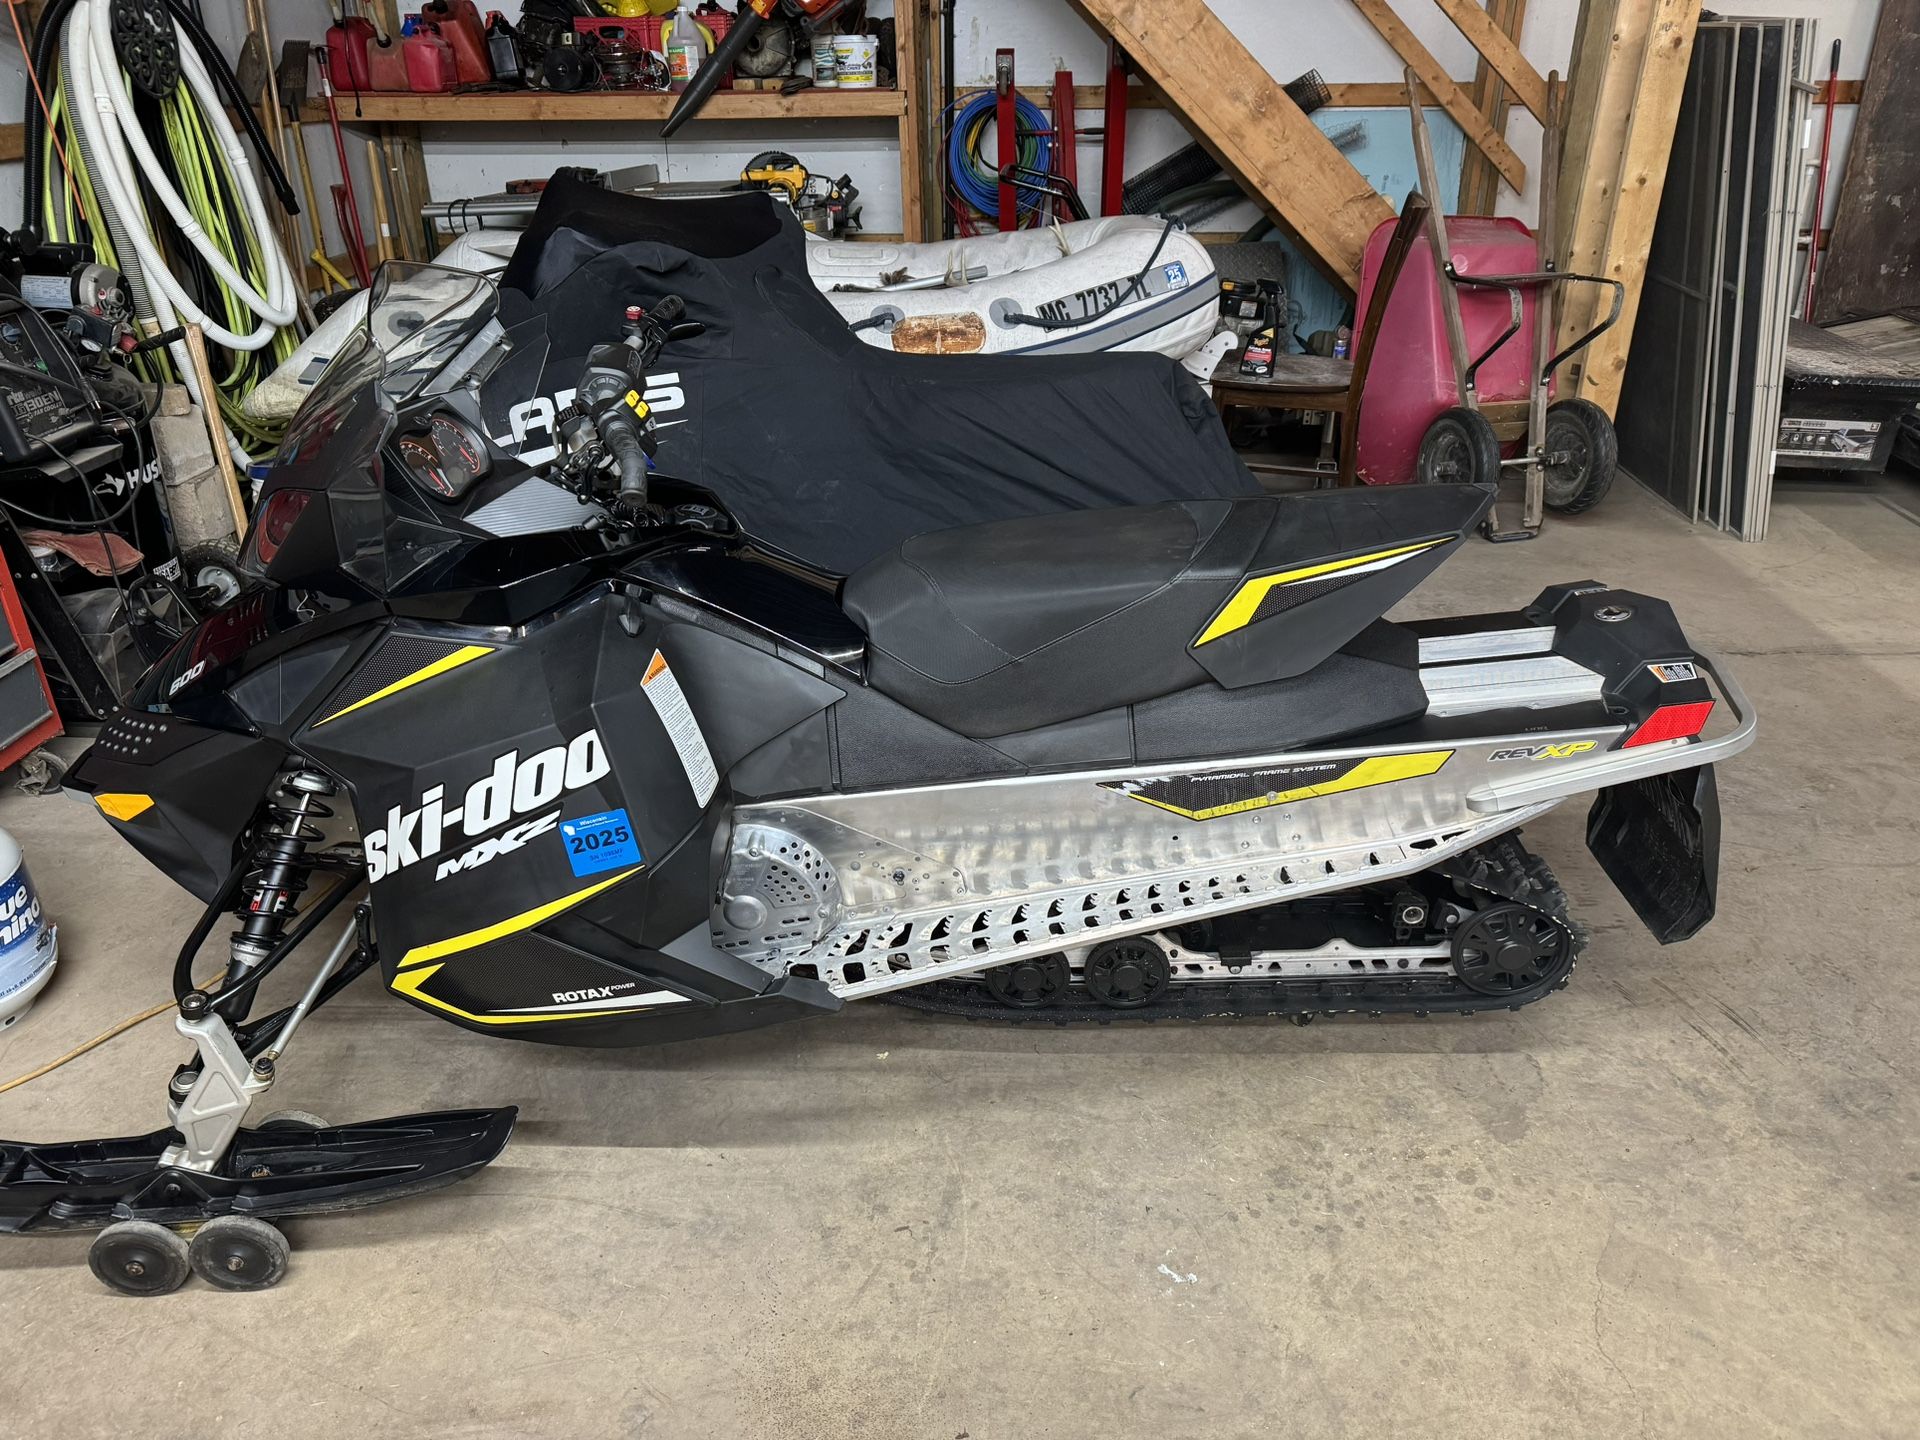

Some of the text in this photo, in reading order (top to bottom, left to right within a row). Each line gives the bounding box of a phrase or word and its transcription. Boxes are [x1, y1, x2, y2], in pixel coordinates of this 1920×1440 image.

[1167, 267, 1182, 284] 25
[1075, 283, 1121, 318] 7737
[126, 459, 161, 490] HUS
[169, 660, 205, 696] 600
[1190, 763, 1337, 783] PYRAMIDAL FRAME SYSTEM
[363, 729, 611, 885] ski-doo
[579, 815, 608, 826] Wisconsin
[569, 825, 629, 855] 2025
[0, 884, 28, 922] ue
[552, 982, 636, 1004] ROTAX POWER
